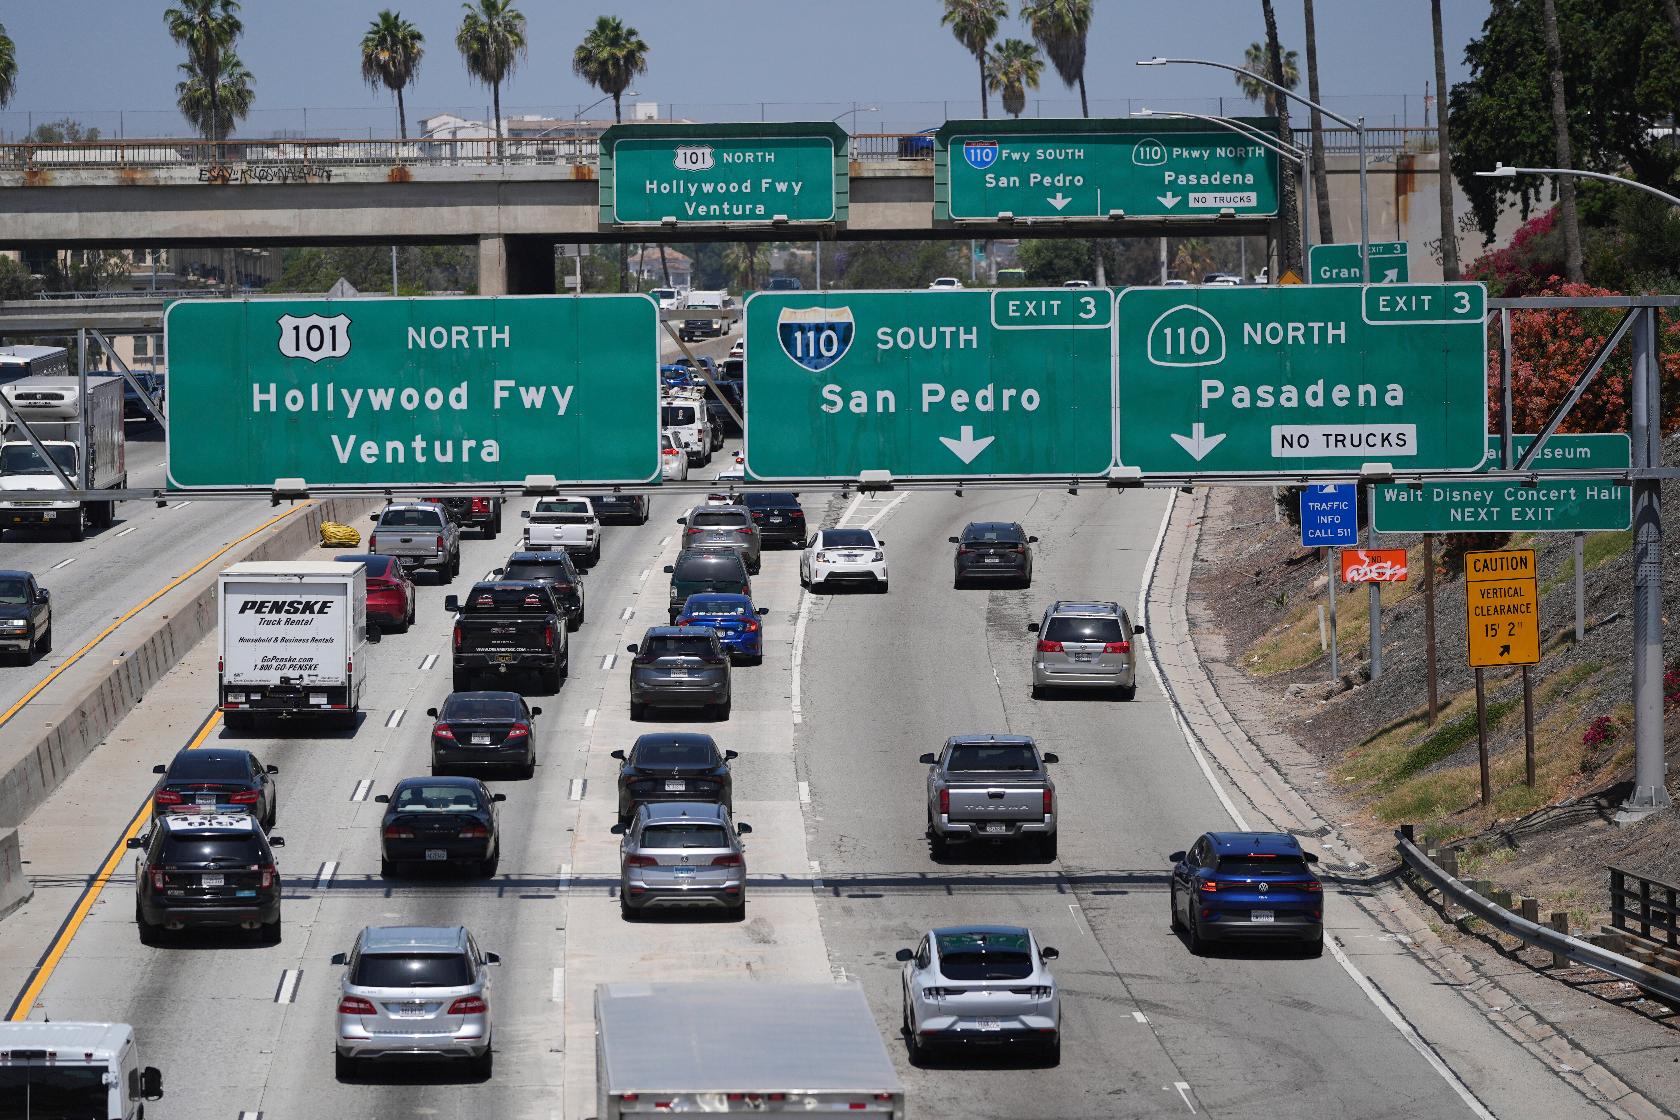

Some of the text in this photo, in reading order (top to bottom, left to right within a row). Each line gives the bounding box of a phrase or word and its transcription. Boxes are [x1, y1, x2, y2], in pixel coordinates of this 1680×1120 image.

[681, 151, 774, 165] 101 NORTH
[970, 149, 1083, 162] 110 Fwy SOUTH
[1139, 145, 1265, 160] 110 Pkwy NORTH
[986, 173, 1083, 187] San Pedro
[1165, 172, 1253, 184] Pasadena
[646, 179, 802, 196] Hollywood Fwy
[1194, 194, 1252, 205] NO TRUCKS
[685, 202, 764, 215] Ventura
[1393, 244, 1401, 253] 3
[1321, 267, 1361, 279] Gran
[1009, 297, 1096, 319] EXIT 3
[1380, 292, 1470, 313] EXIT 3
[292, 325, 509, 352] 101 NORTH
[794, 327, 977, 357] 110 SOUTH
[1164, 322, 1345, 355] 110 NORTH
[253, 380, 573, 418] Hollywood Fwy
[821, 383, 1040, 413] San Pedro
[1200, 379, 1403, 408] Pasadena
[1282, 433, 1406, 448] NO TRUCKS
[331, 434, 499, 463] Ventura
[1517, 445, 1591, 459] Mseum
[1384, 487, 1621, 504] Walt Disney Concert Hall
[1309, 502, 1348, 510] TRAFFIC
[1451, 508, 1554, 521] NEXT EXIT
[1309, 529, 1334, 537] CALL
[1474, 556, 1527, 572] CAUTION
[1480, 587, 1525, 599] VERTICAL
[238, 600, 334, 614] PENSKE
[1475, 603, 1531, 616] CLEARANCE
[1485, 622, 1522, 637] 15' 2"
